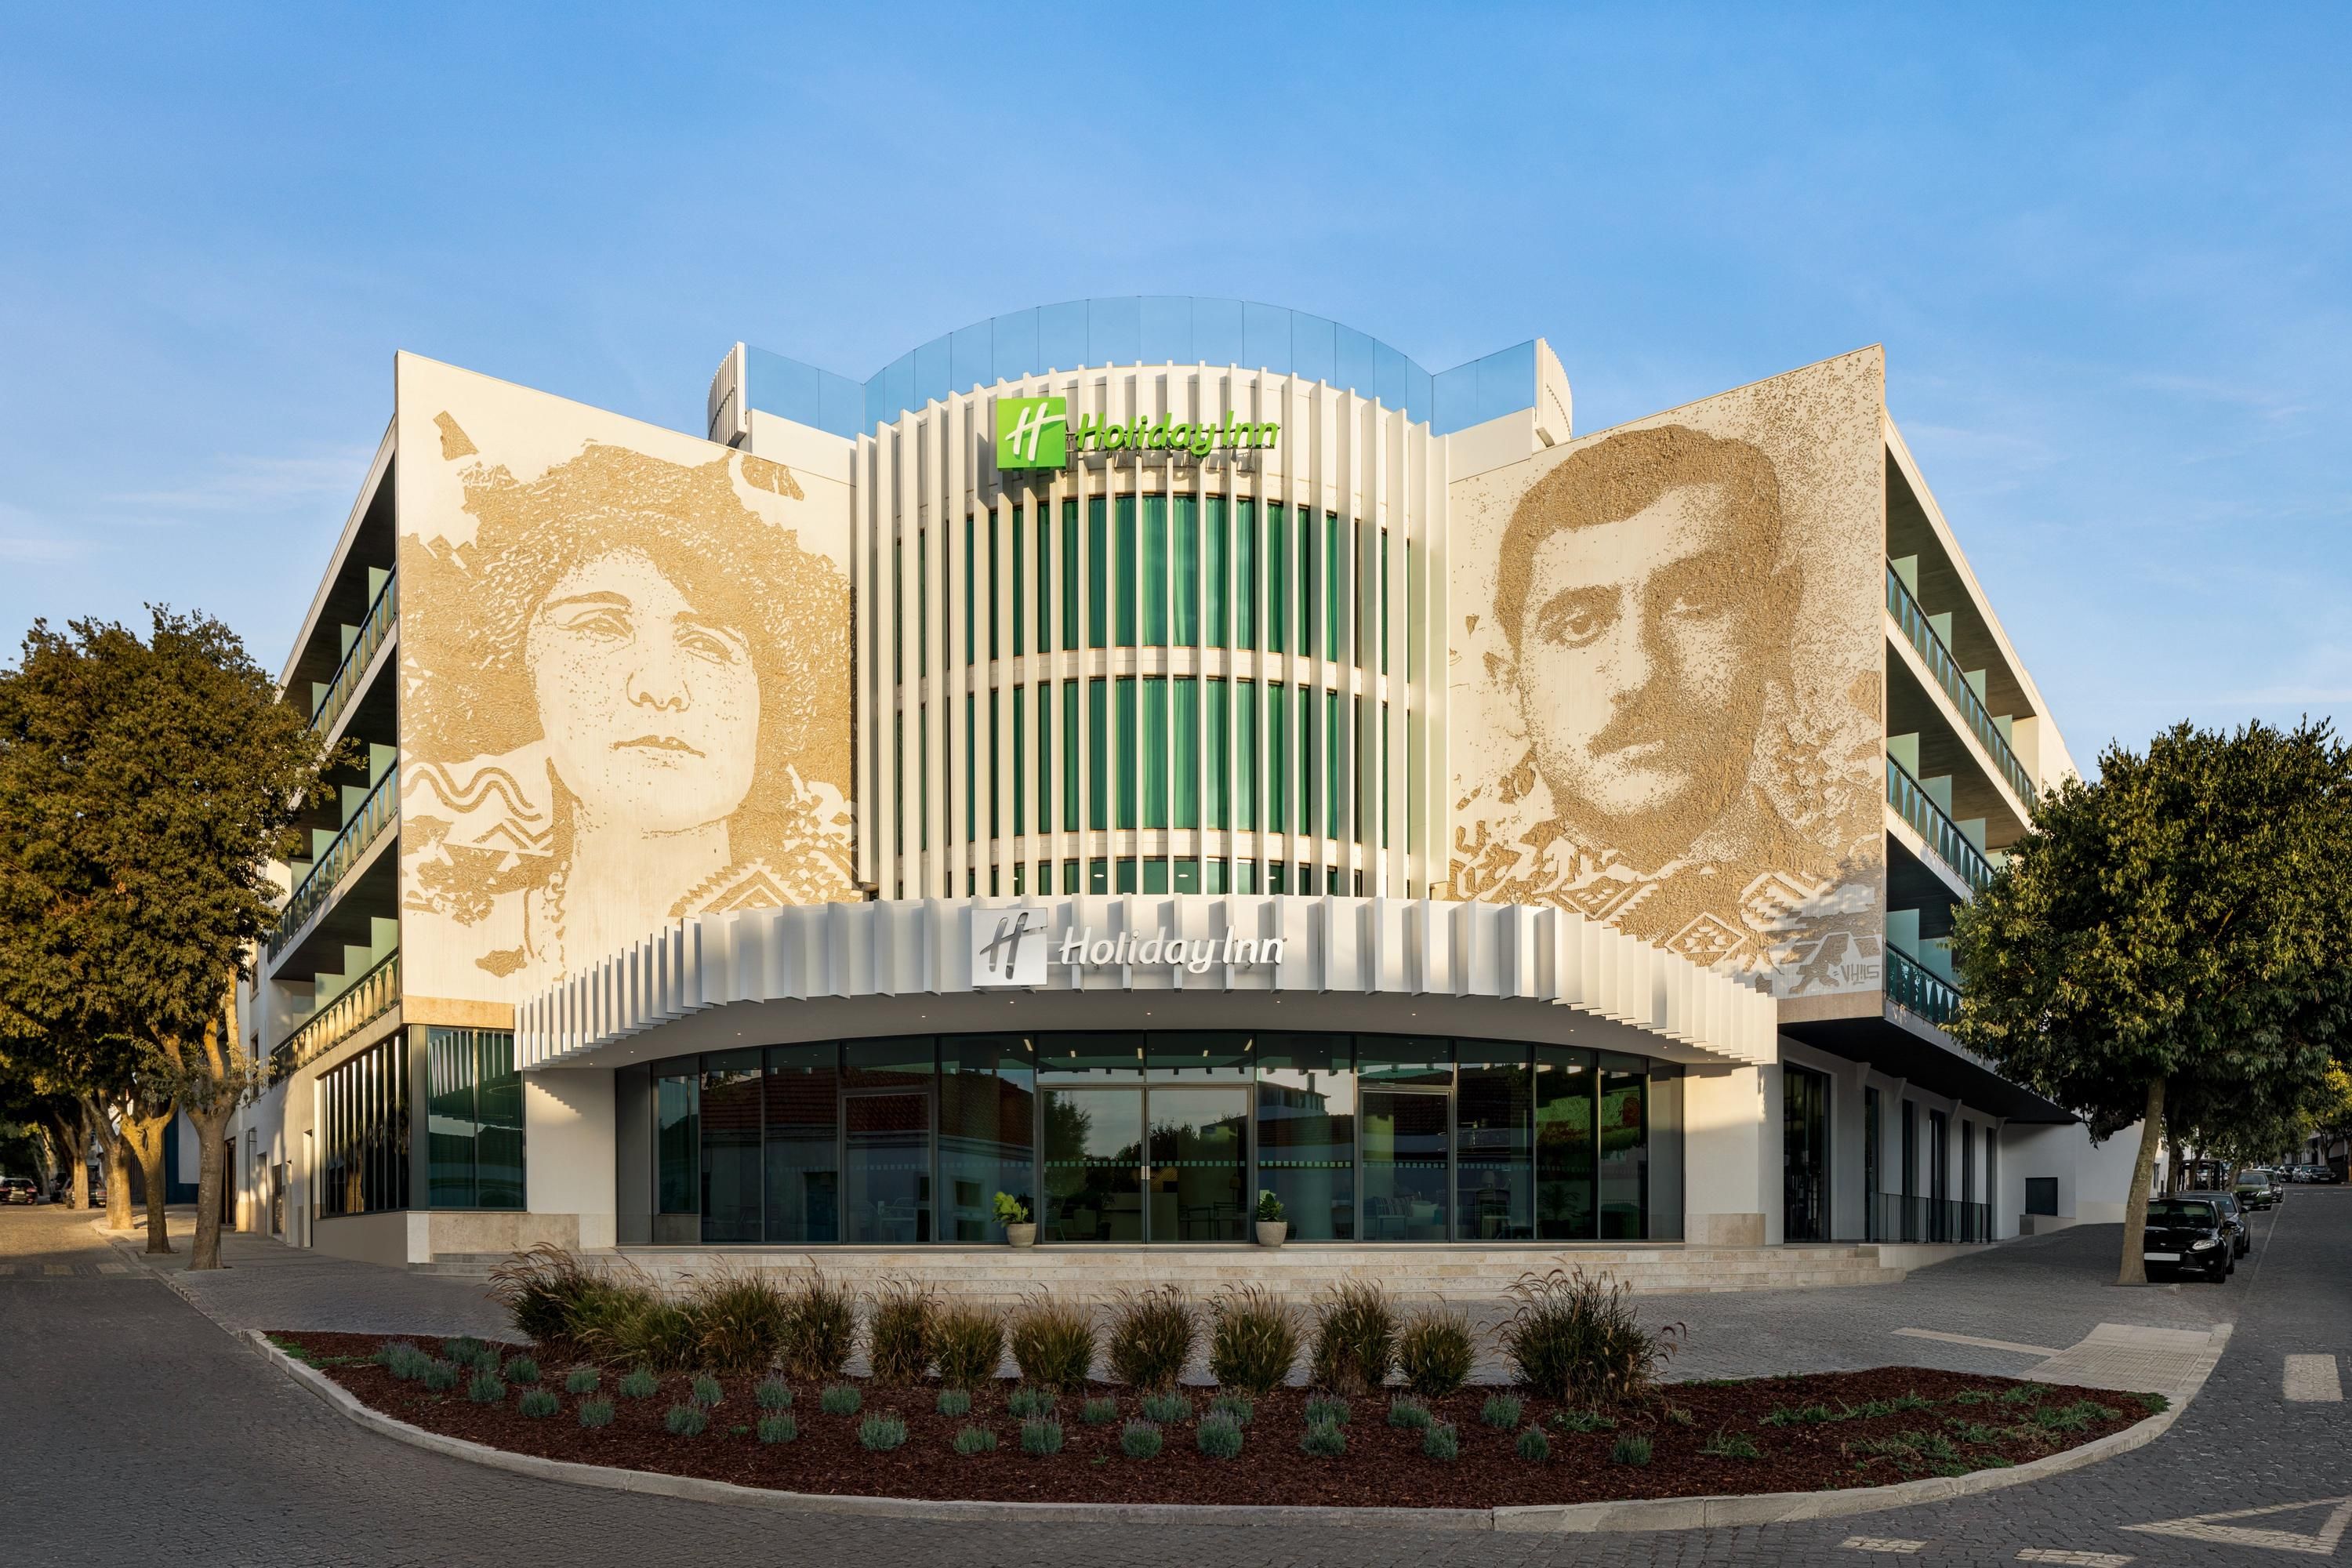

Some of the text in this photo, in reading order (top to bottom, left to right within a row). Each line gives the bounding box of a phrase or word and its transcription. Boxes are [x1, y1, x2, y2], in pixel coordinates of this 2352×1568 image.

[1075, 410, 1279, 458] Holiday Inn
[1058, 925, 1284, 974] Holiday Inn
